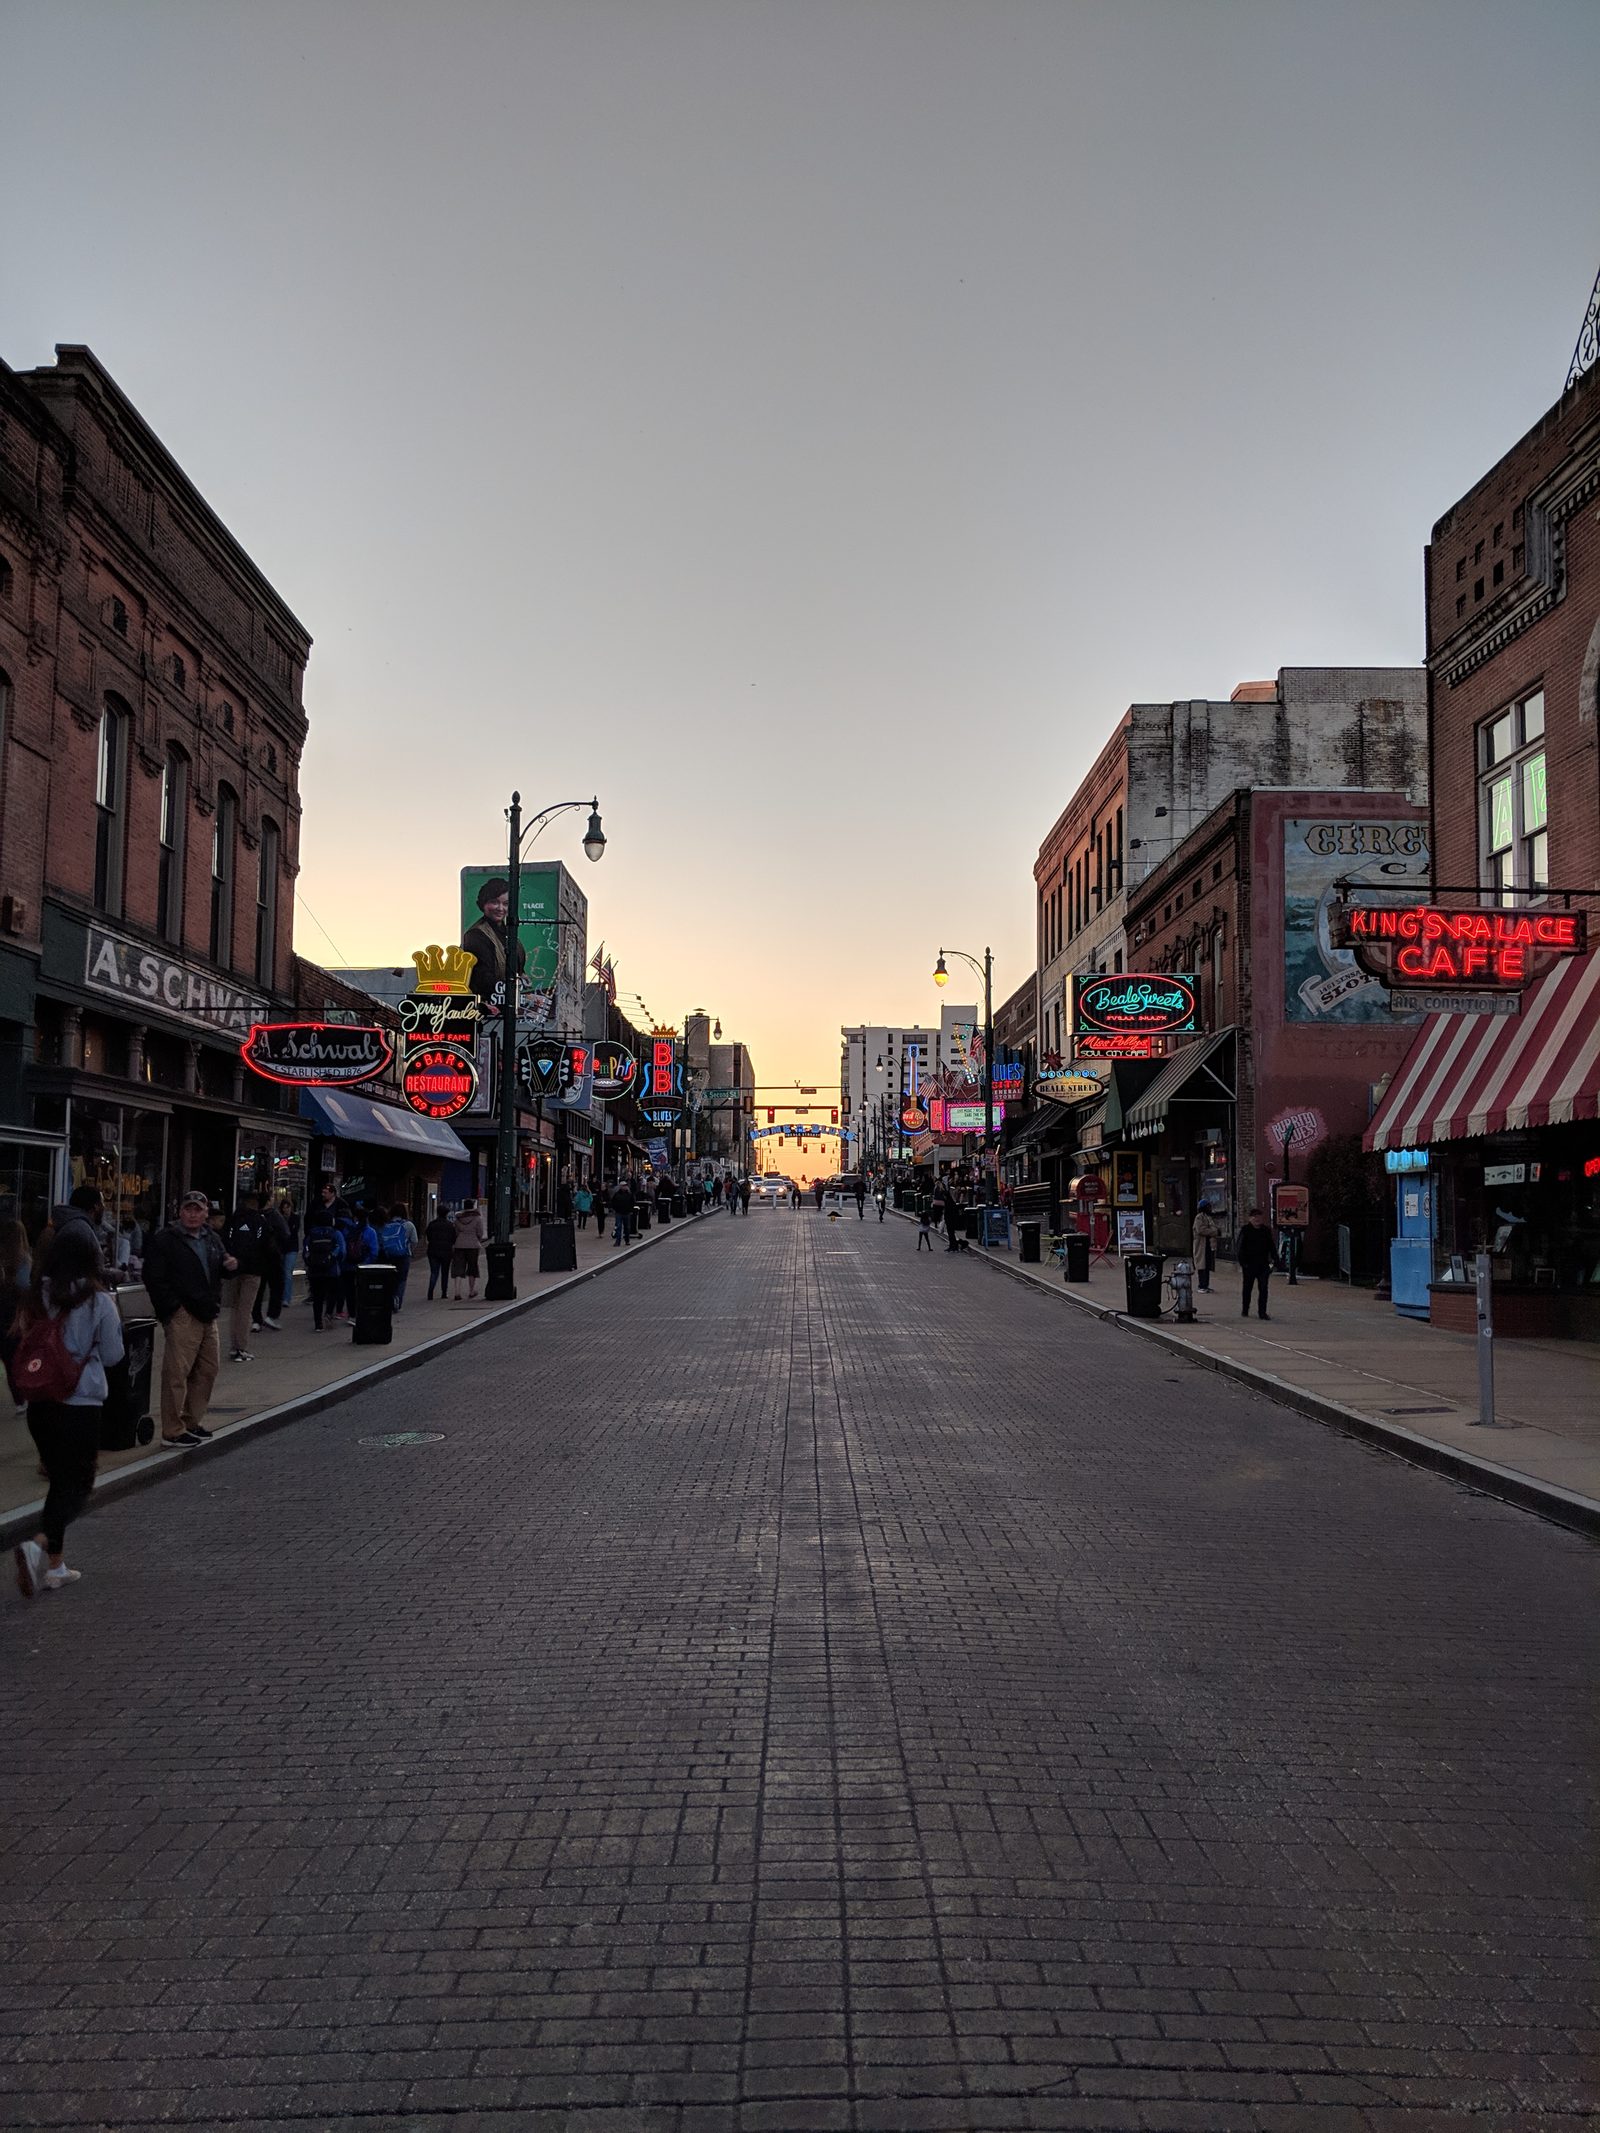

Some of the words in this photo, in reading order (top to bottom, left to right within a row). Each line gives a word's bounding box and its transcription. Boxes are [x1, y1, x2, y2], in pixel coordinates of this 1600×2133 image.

[1352, 906, 1441, 940] KING'S
[1457, 915, 1575, 944] PALACE
[1399, 946, 1523, 977] CAFE
[1336, 970, 1362, 984] SENSA
[1087, 985, 1139, 1011] Beale
[1132, 984, 1185, 1014] Sweets
[1321, 975, 1380, 1005] SLOT
[1393, 996, 1417, 1010] AIR
[398, 1000, 442, 1032] Jerry
[432, 996, 484, 1034] Lawler
[282, 1030, 380, 1060] Schwab
[423, 1052, 456, 1065] BAR
[592, 1053, 637, 1081] emphis
[275, 1065, 340, 1077] ESTABLISHED
[343, 1067, 362, 1077] 1876
[992, 1063, 1021, 1081] LUES
[406, 1076, 471, 1092] RESTAURANT
[992, 1080, 1021, 1089] CITY
[1068, 1084, 1098, 1092] STREET
[411, 1095, 427, 1111] 159
[430, 1095, 466, 1117] BEALE
[653, 1111, 672, 1121] BLUES
